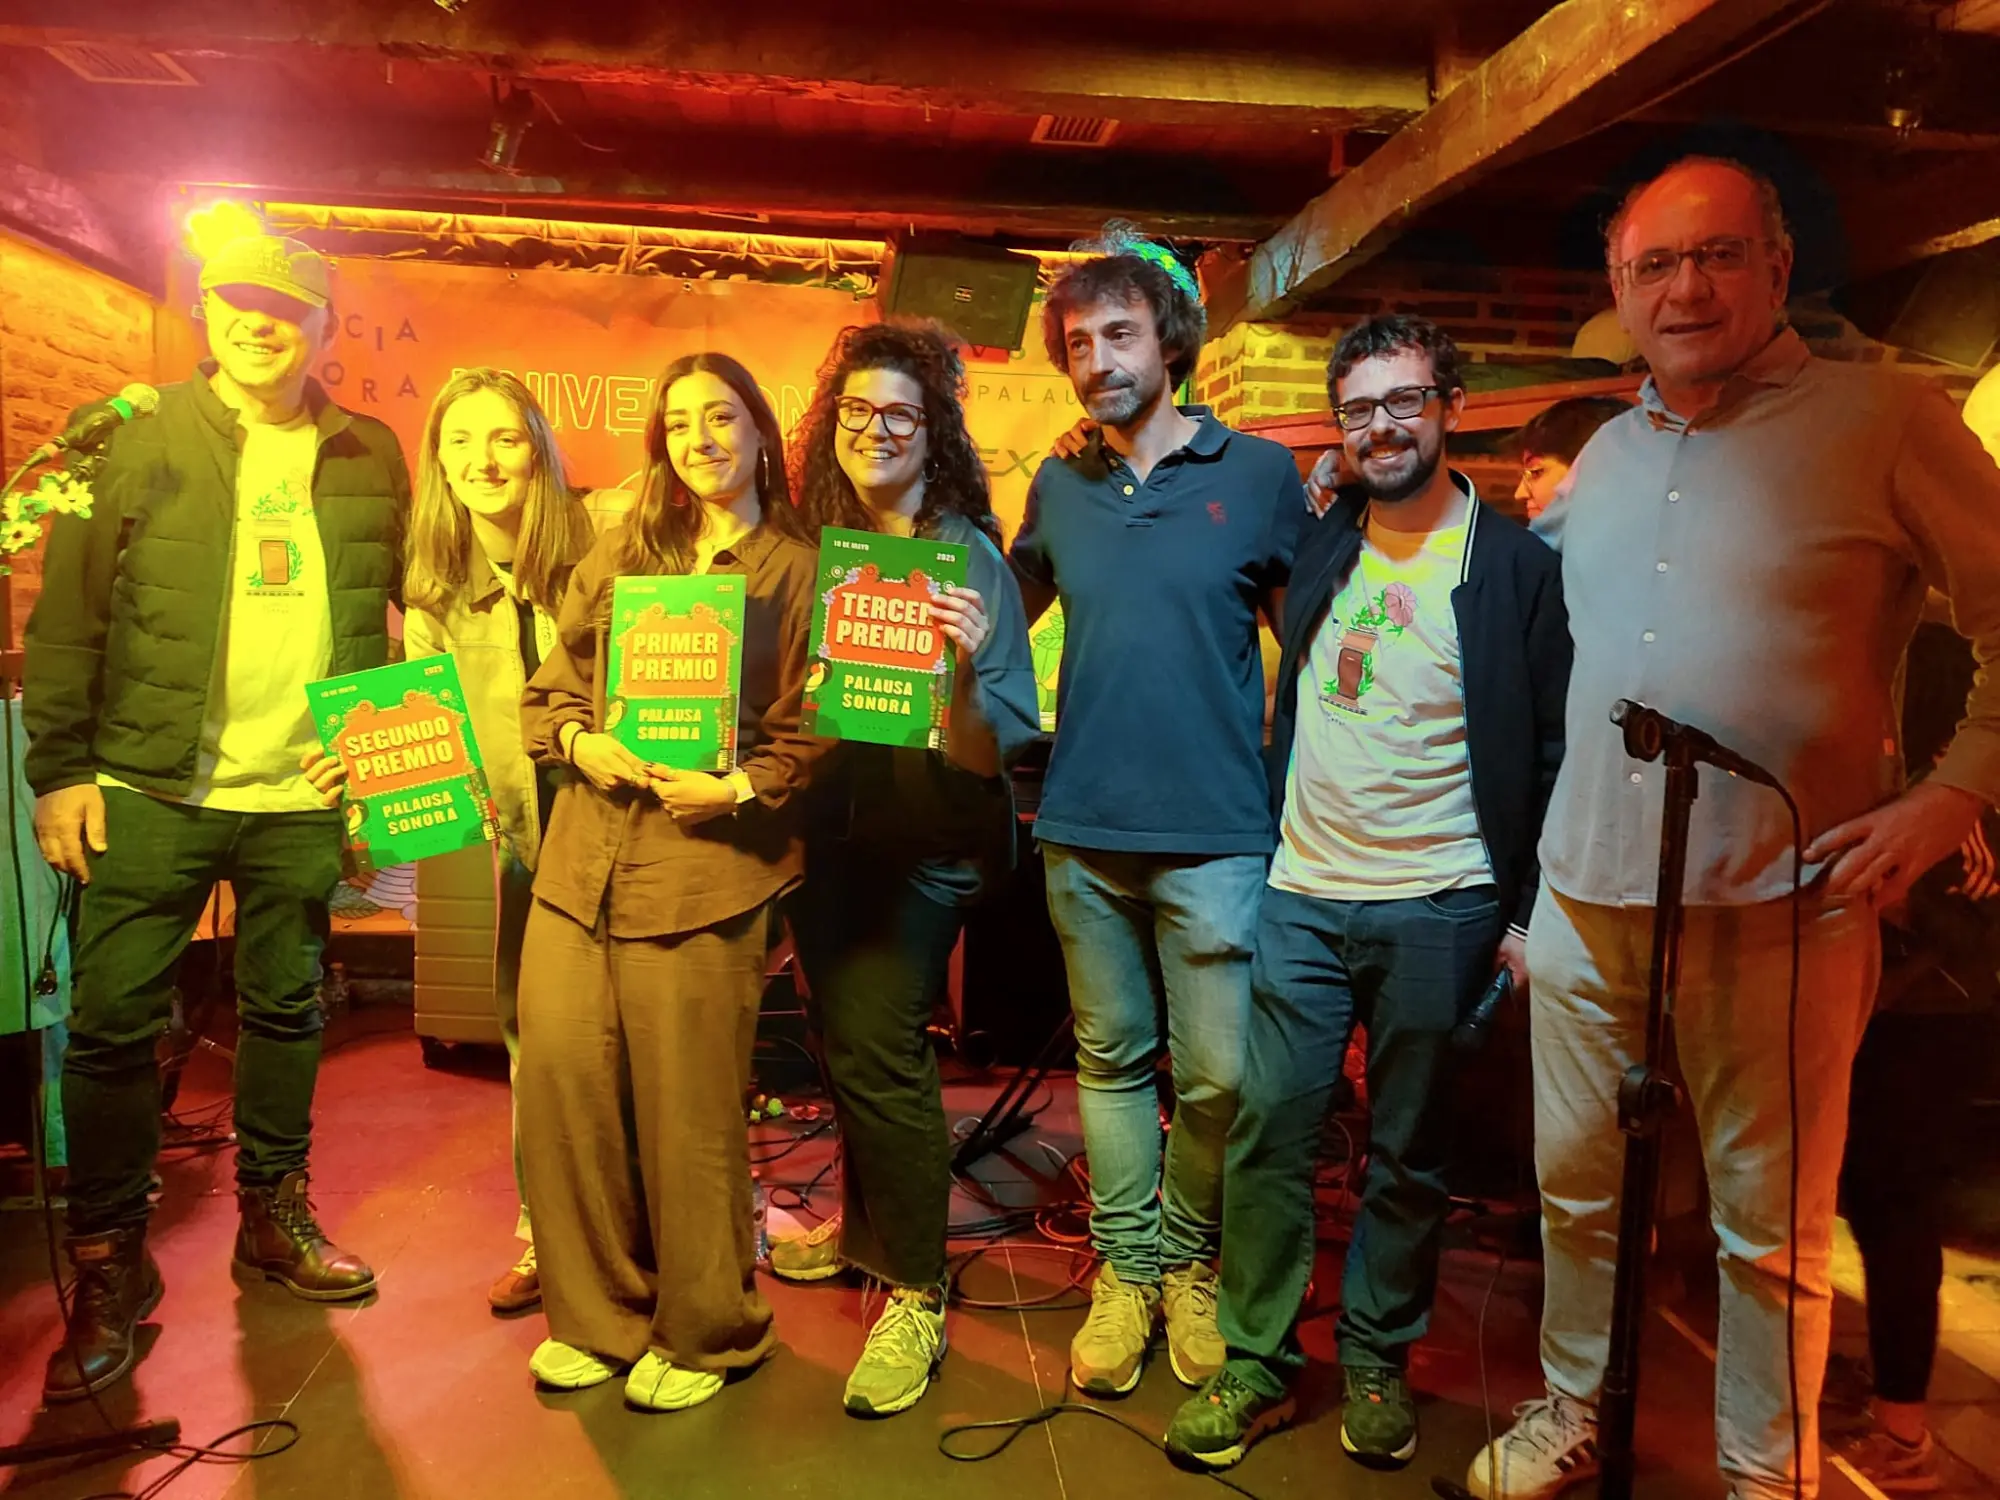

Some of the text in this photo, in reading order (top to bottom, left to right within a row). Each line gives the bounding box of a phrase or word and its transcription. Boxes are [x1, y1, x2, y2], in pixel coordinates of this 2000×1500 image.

[936, 552, 956, 563] 2025
[633, 632, 719, 654] PRIMER
[836, 619, 933, 656] PREMIO
[631, 658, 718, 681] PREMIO
[843, 674, 914, 696] PALAUSA
[638, 708, 702, 723] PALAUSA
[842, 693, 912, 716] SONORA
[344, 716, 451, 757] SEGUNDO
[637, 726, 700, 741] SONORA
[355, 740, 454, 782] PREMIO
[382, 790, 453, 818] PALAUSA
[387, 808, 458, 836] SONORA
